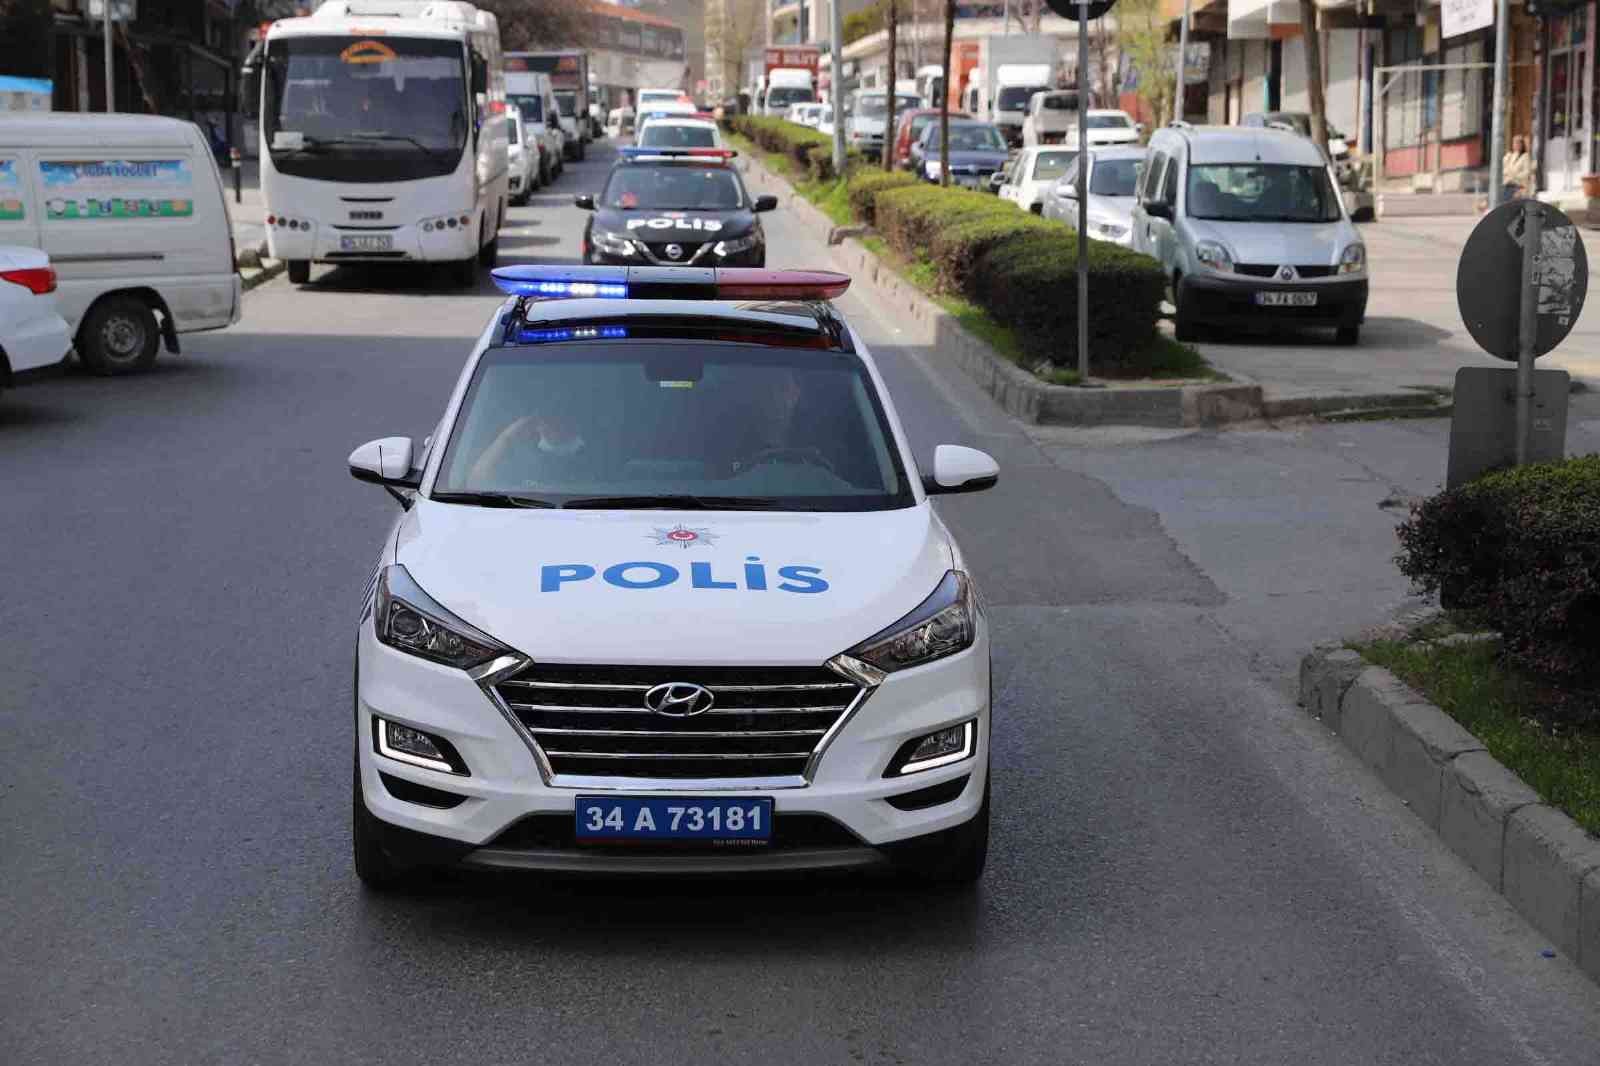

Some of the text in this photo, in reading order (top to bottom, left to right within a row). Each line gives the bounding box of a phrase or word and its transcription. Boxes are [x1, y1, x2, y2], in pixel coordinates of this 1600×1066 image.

[540, 556, 829, 594] POLİS
[586, 806, 761, 831] 34 A 73181
